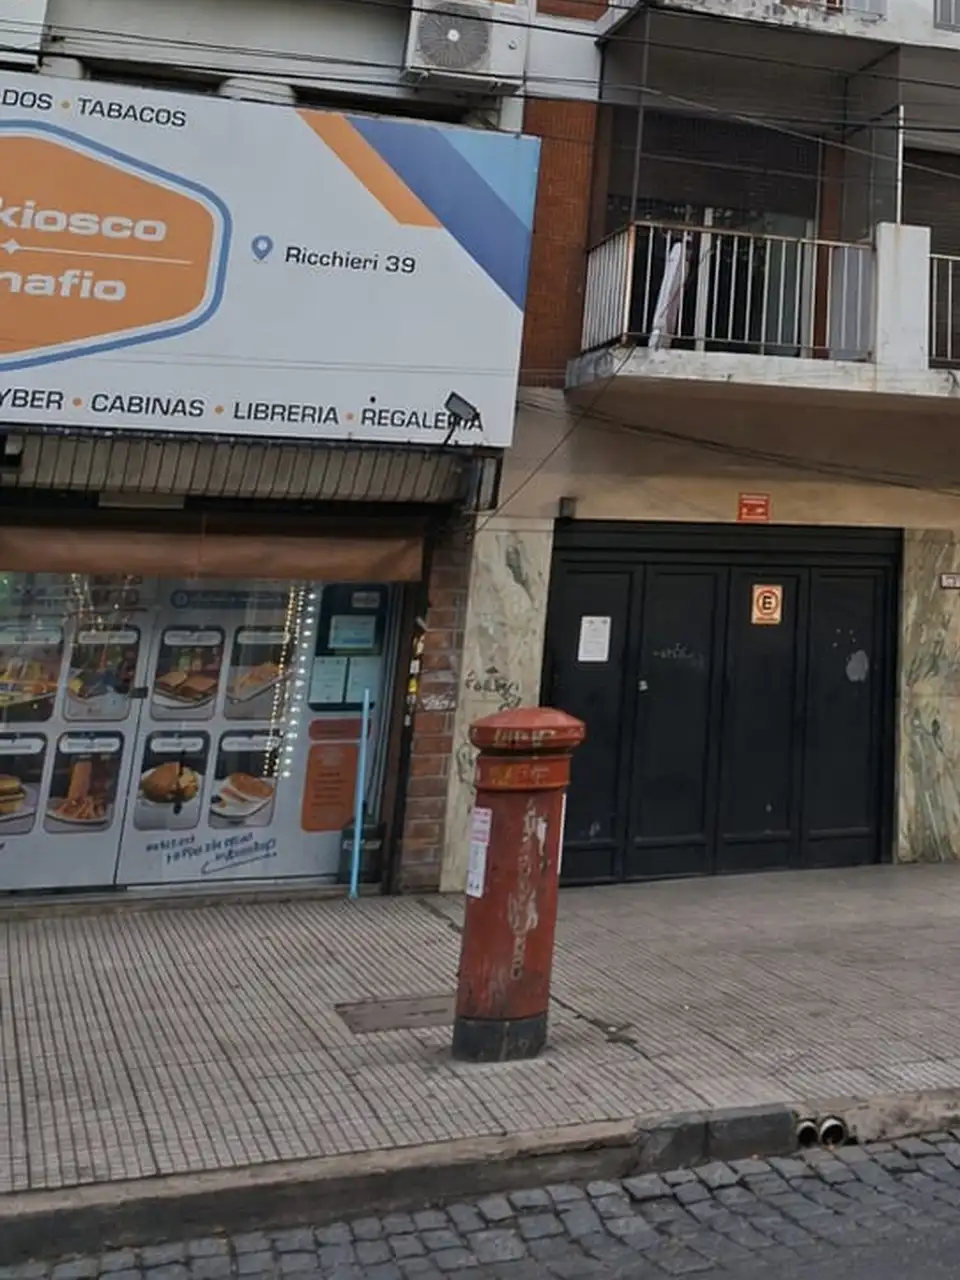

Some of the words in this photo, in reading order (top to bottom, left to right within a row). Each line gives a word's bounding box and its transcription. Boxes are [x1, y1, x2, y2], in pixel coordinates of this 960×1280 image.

[78, 97, 187, 128] TABACOS
[285, 246, 379, 271] Ricchieri
[385, 255, 416, 273] 39
[91, 393, 205, 417] CABINAS
[233, 402, 339, 425] LIBRERIA
[762, 595, 773, 610] E
